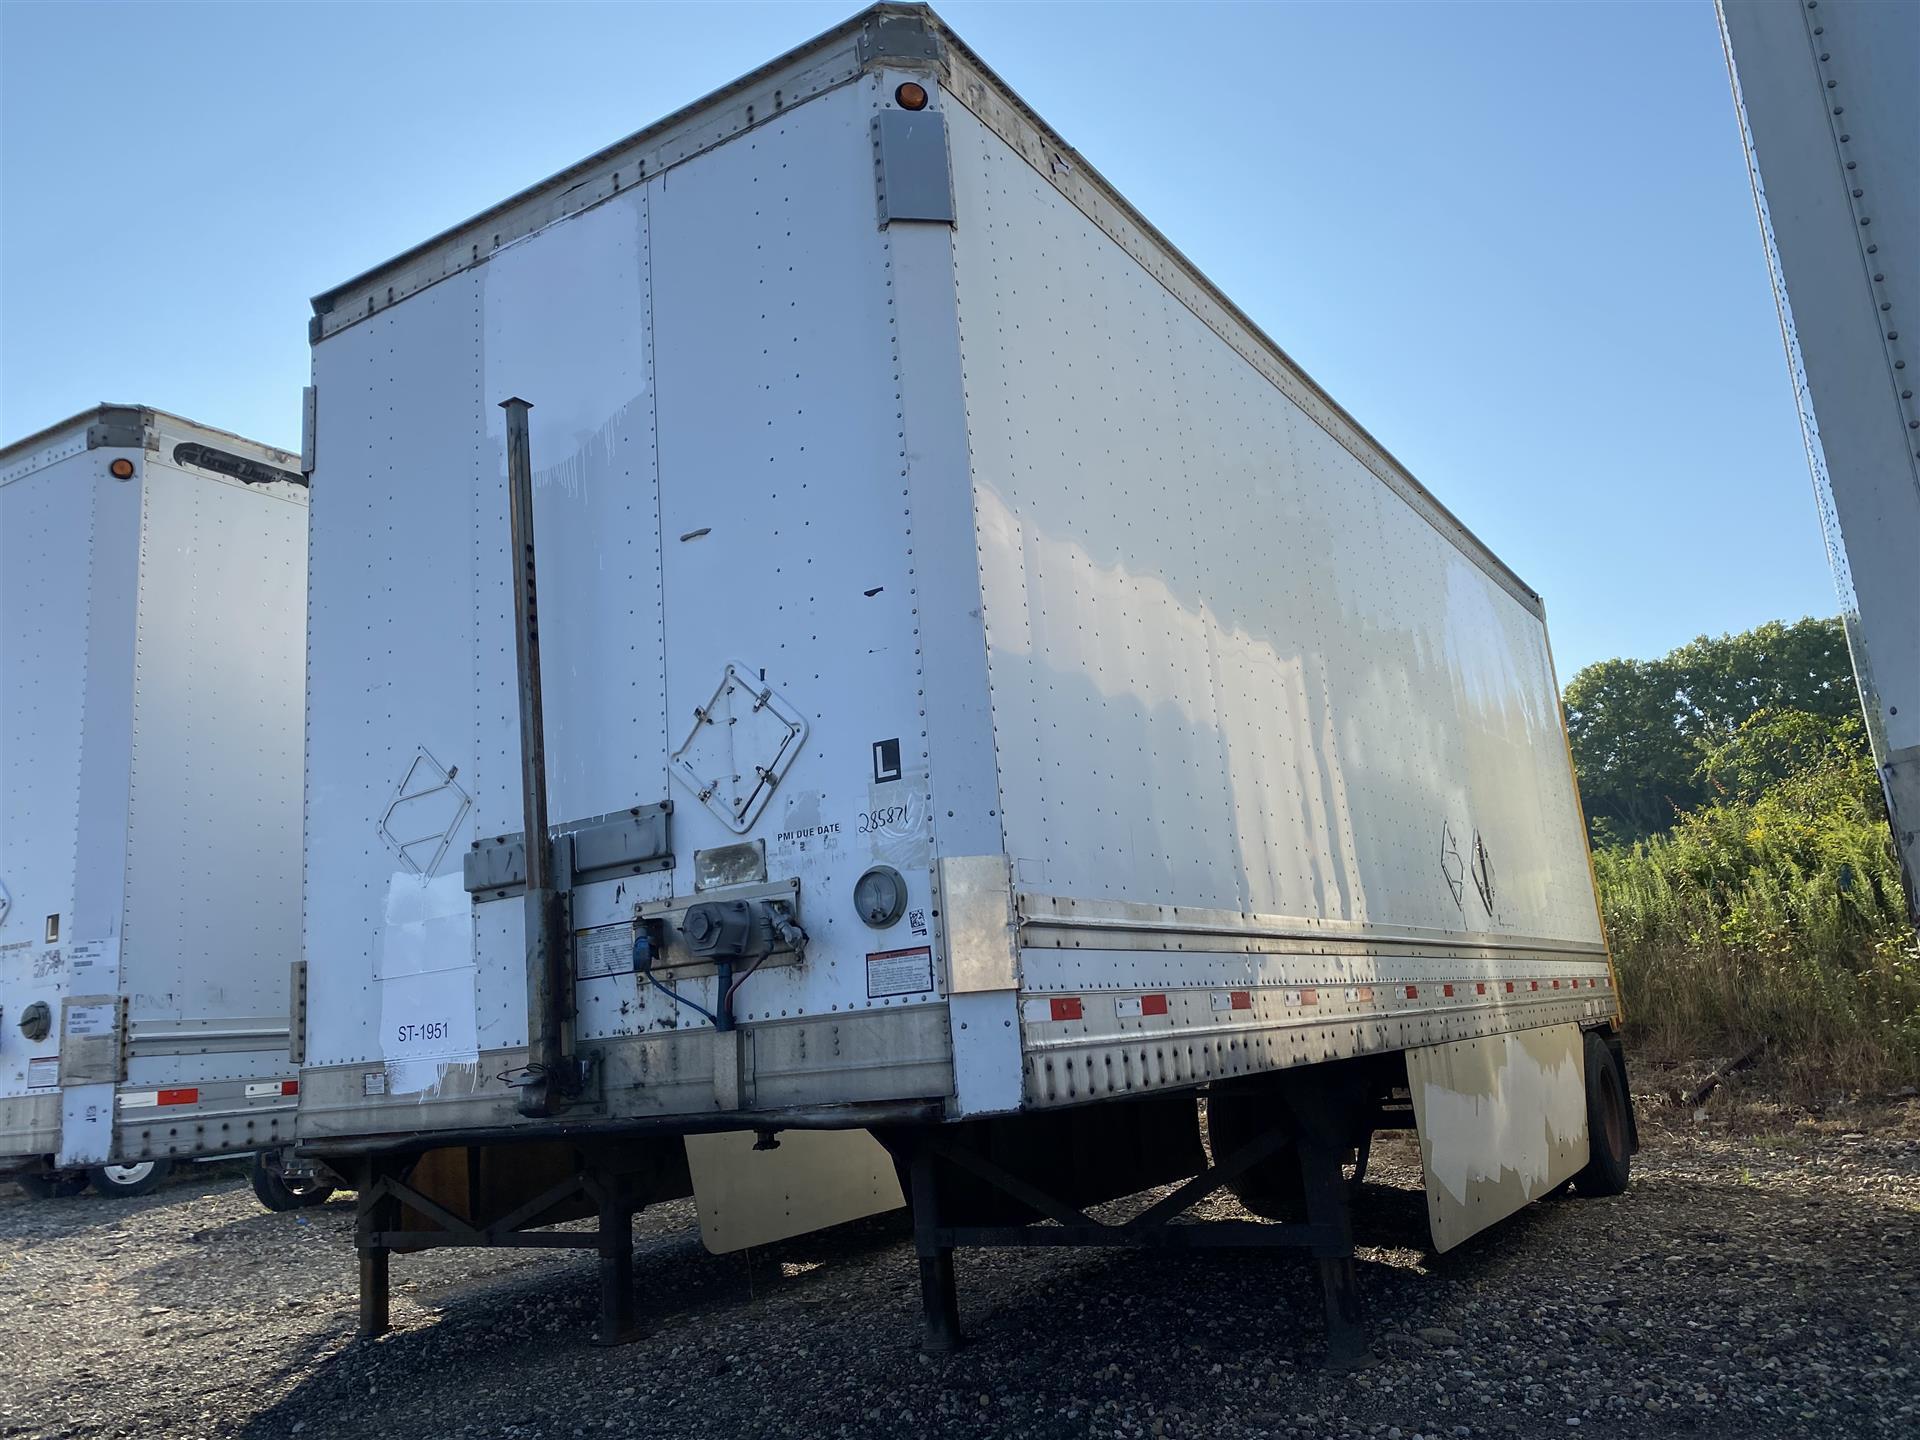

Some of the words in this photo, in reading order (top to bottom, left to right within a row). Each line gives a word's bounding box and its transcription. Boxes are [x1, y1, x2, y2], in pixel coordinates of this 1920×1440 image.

[875, 744, 898, 779] L
[777, 832, 794, 842] PMI
[797, 828, 814, 839] DUE
[817, 823, 840, 835] DATE
[398, 1022, 448, 1042] ST-1951
